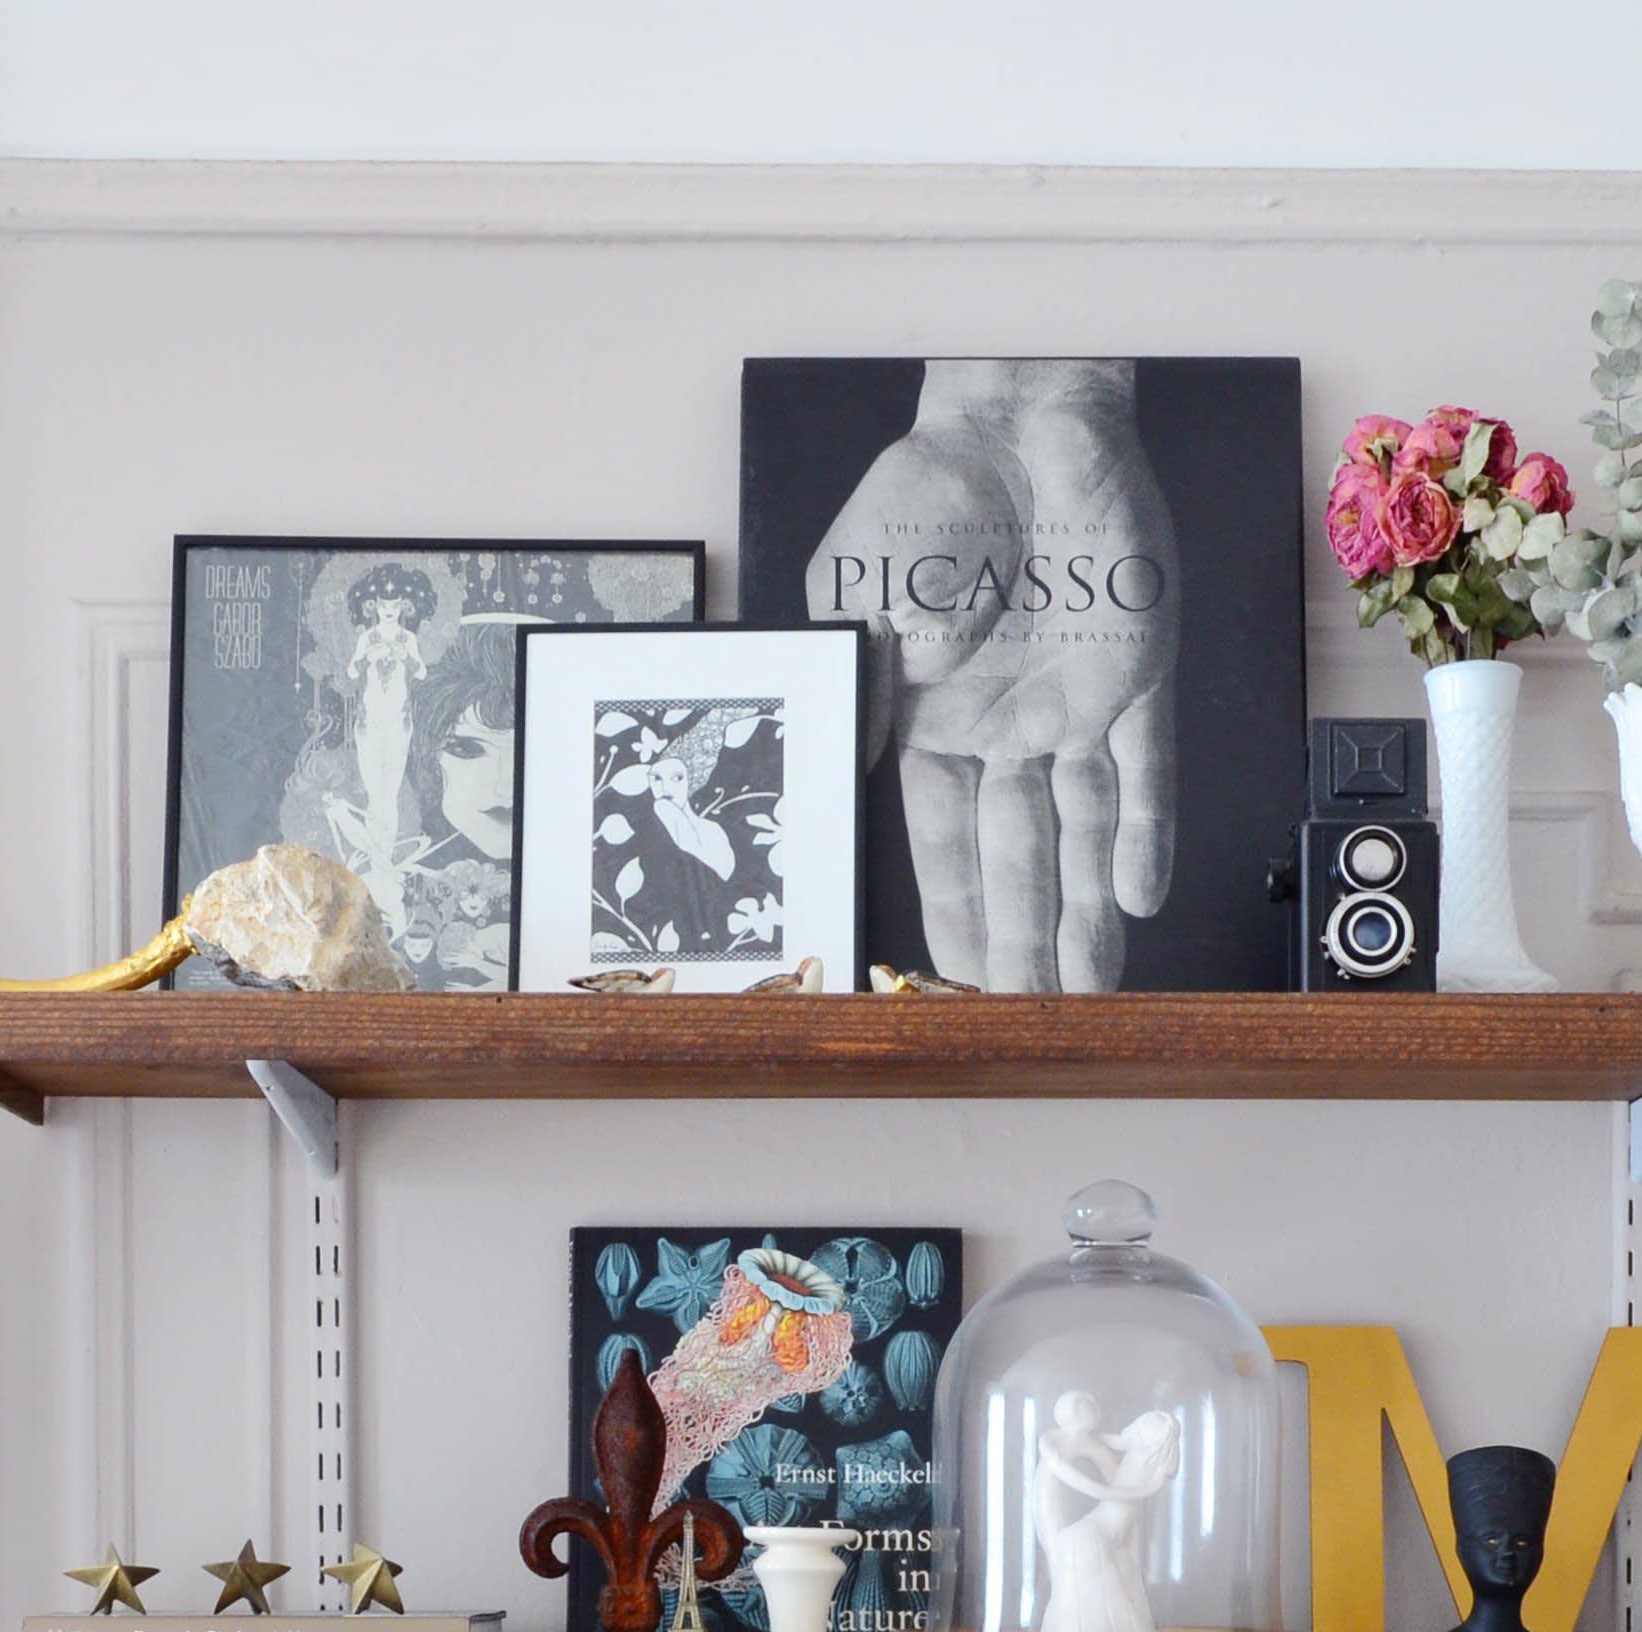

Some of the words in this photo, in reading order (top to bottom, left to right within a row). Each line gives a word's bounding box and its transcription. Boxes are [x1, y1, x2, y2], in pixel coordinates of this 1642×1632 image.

[883, 523, 921, 535] THE
[936, 523, 1071, 535] SCULPTURES
[1084, 523, 1112, 535] OF
[205, 565, 271, 599] DREAMS
[829, 555, 1166, 613] PICASSO
[213, 602, 262, 636] GABOR
[214, 635, 262, 669] SZABO
[867, 632, 1009, 643] OTOGRAPHS
[1022, 632, 1045, 643] BY
[775, 1462, 837, 1484] Ernst
[844, 1461, 933, 1484] Haeckel
[898, 1559, 931, 1592] in
